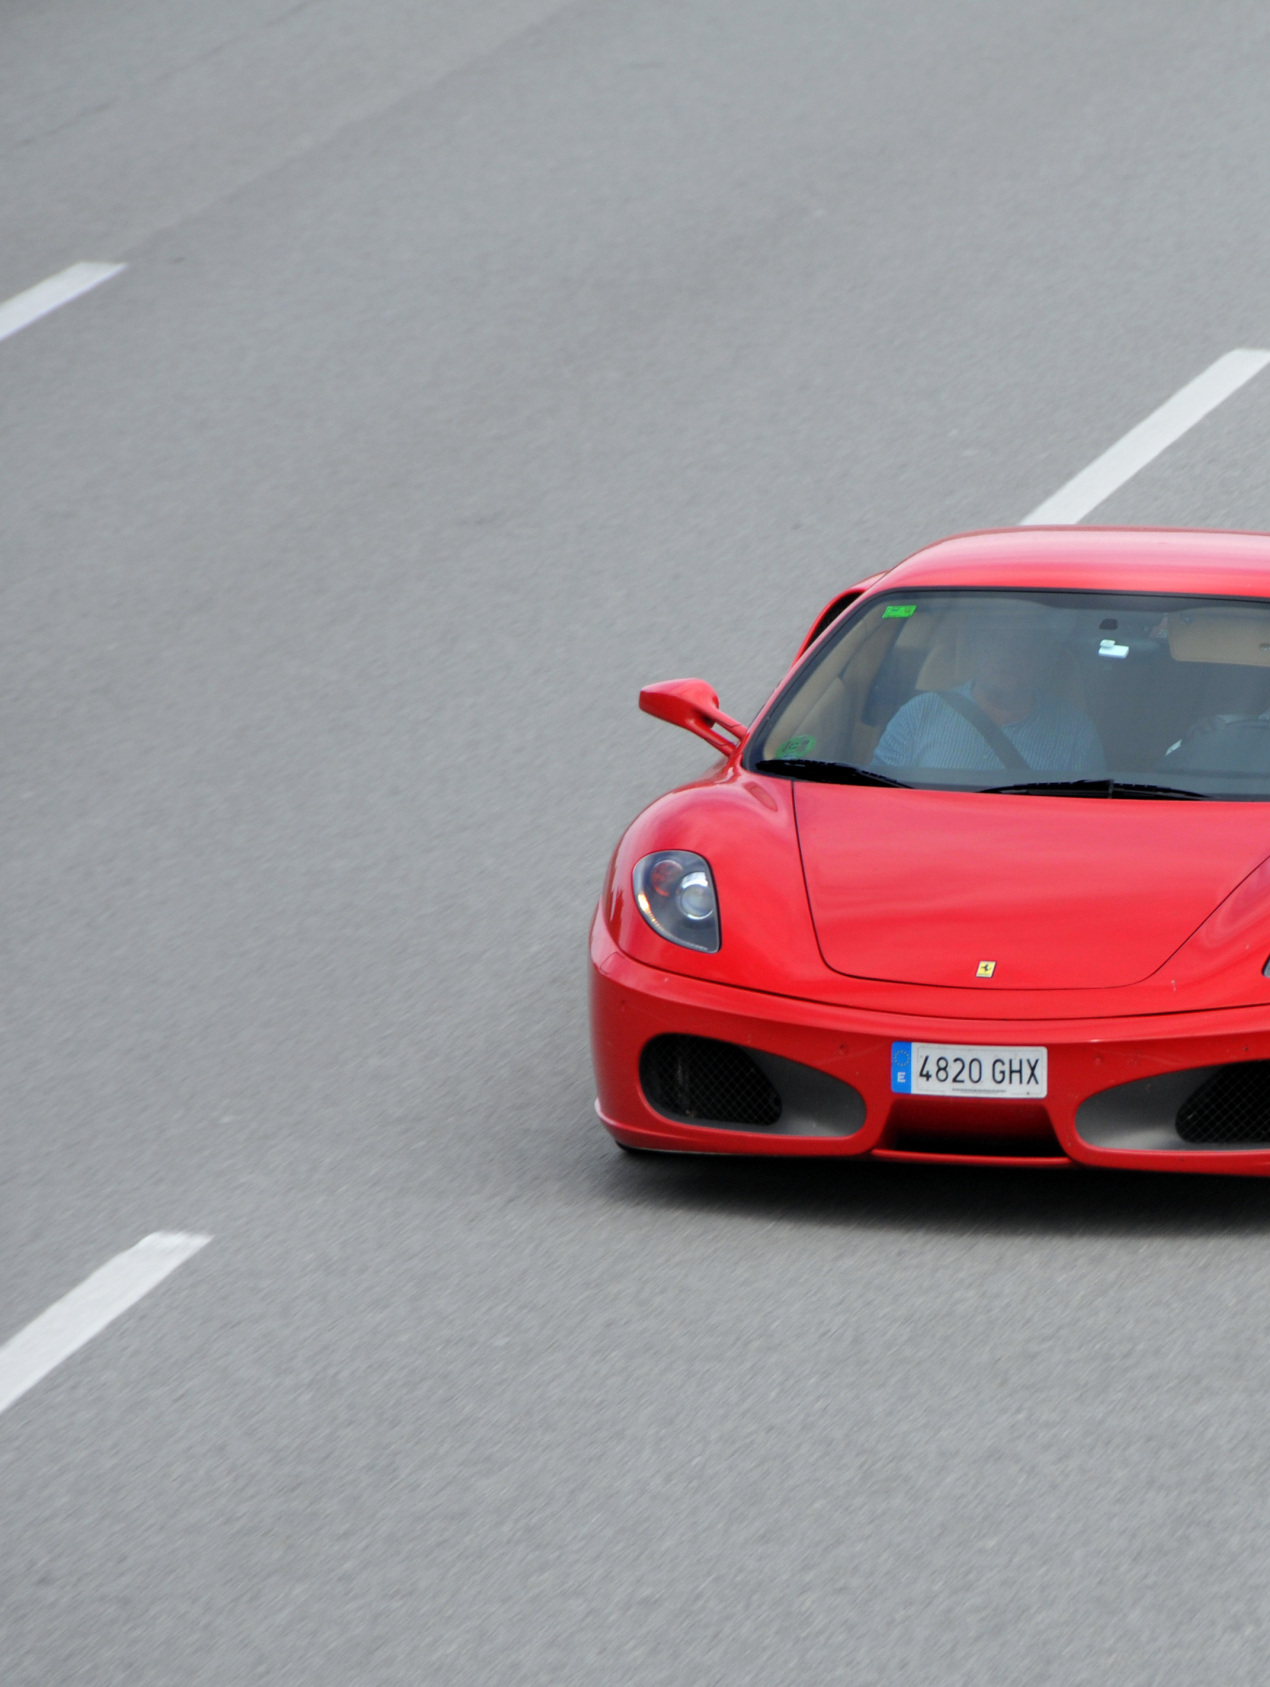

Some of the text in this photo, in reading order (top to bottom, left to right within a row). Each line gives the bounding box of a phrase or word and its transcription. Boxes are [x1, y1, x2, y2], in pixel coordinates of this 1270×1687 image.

[897, 1072, 906, 1083] E
[919, 1055, 1040, 1085] 4820 GHX
